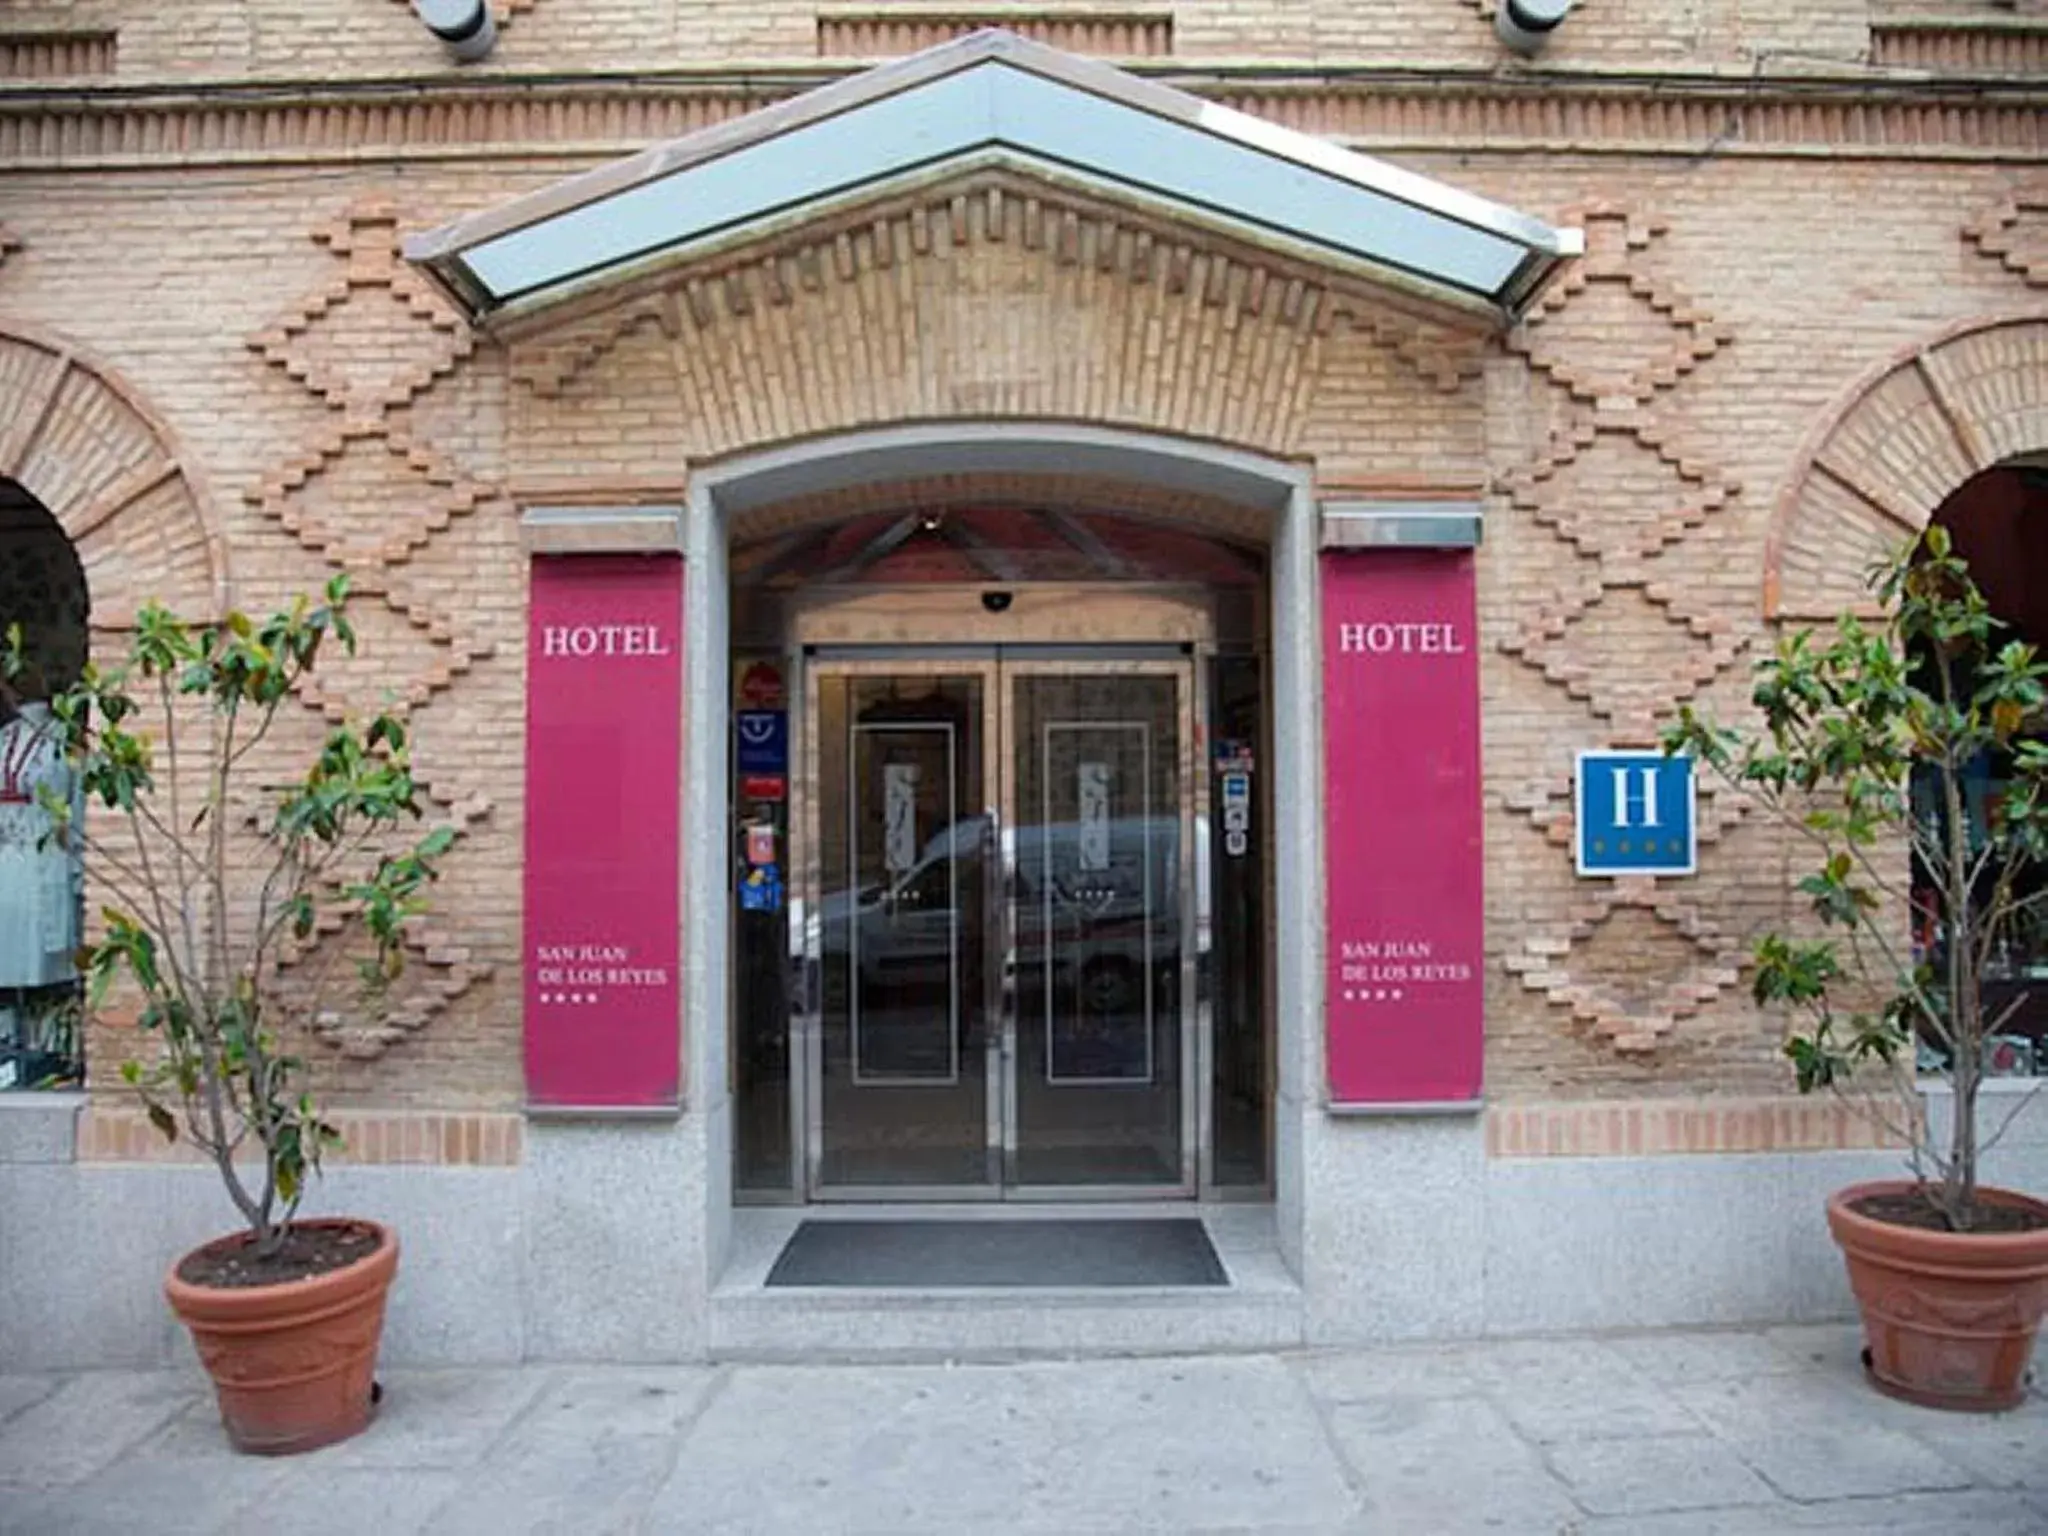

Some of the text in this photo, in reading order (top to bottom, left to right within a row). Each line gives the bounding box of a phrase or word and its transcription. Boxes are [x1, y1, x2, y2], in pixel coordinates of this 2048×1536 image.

[543, 627, 669, 656] HOTEL
[1340, 623, 1466, 653] HOTEL
[1610, 766, 1664, 828] H
[538, 946, 627, 962] SAN JUAN
[1341, 942, 1430, 958] SAN JUAN
[538, 968, 668, 986] DE LOS REYES
[1341, 965, 1472, 981] DE LOS REYES
